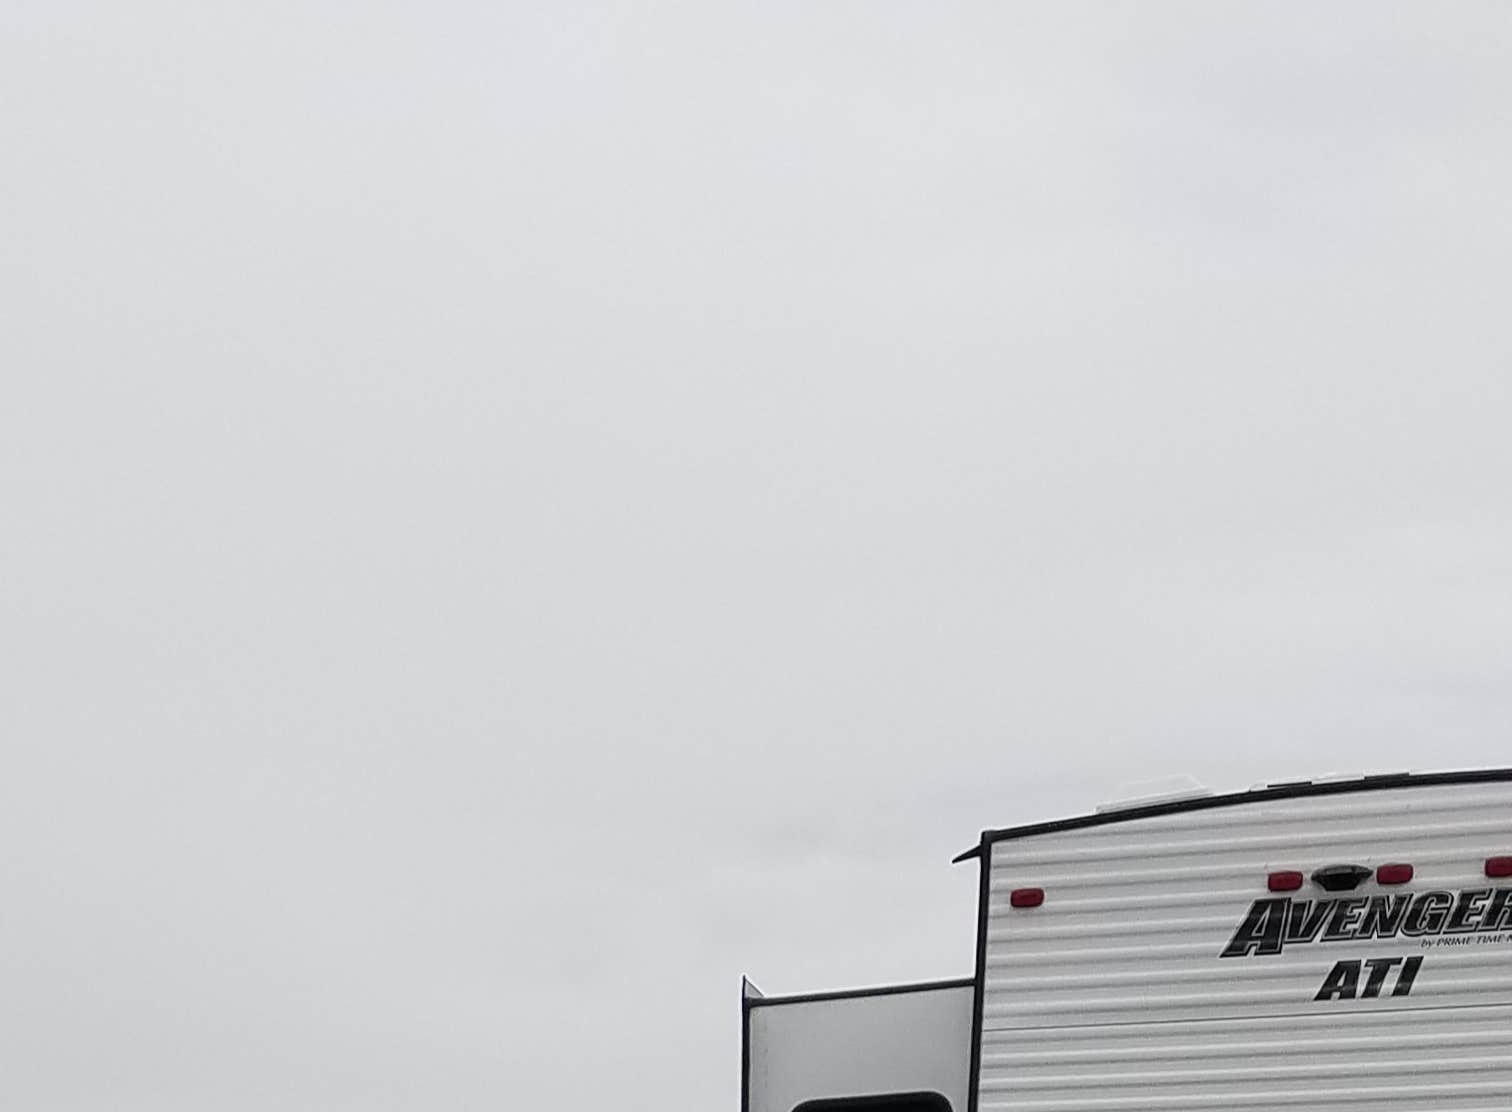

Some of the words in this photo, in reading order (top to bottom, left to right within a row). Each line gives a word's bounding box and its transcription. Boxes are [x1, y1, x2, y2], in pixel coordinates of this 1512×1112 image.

[1437, 935, 1472, 946] PRIME
[1476, 933, 1504, 944] TIME
[1313, 956, 1423, 1000] ATI
